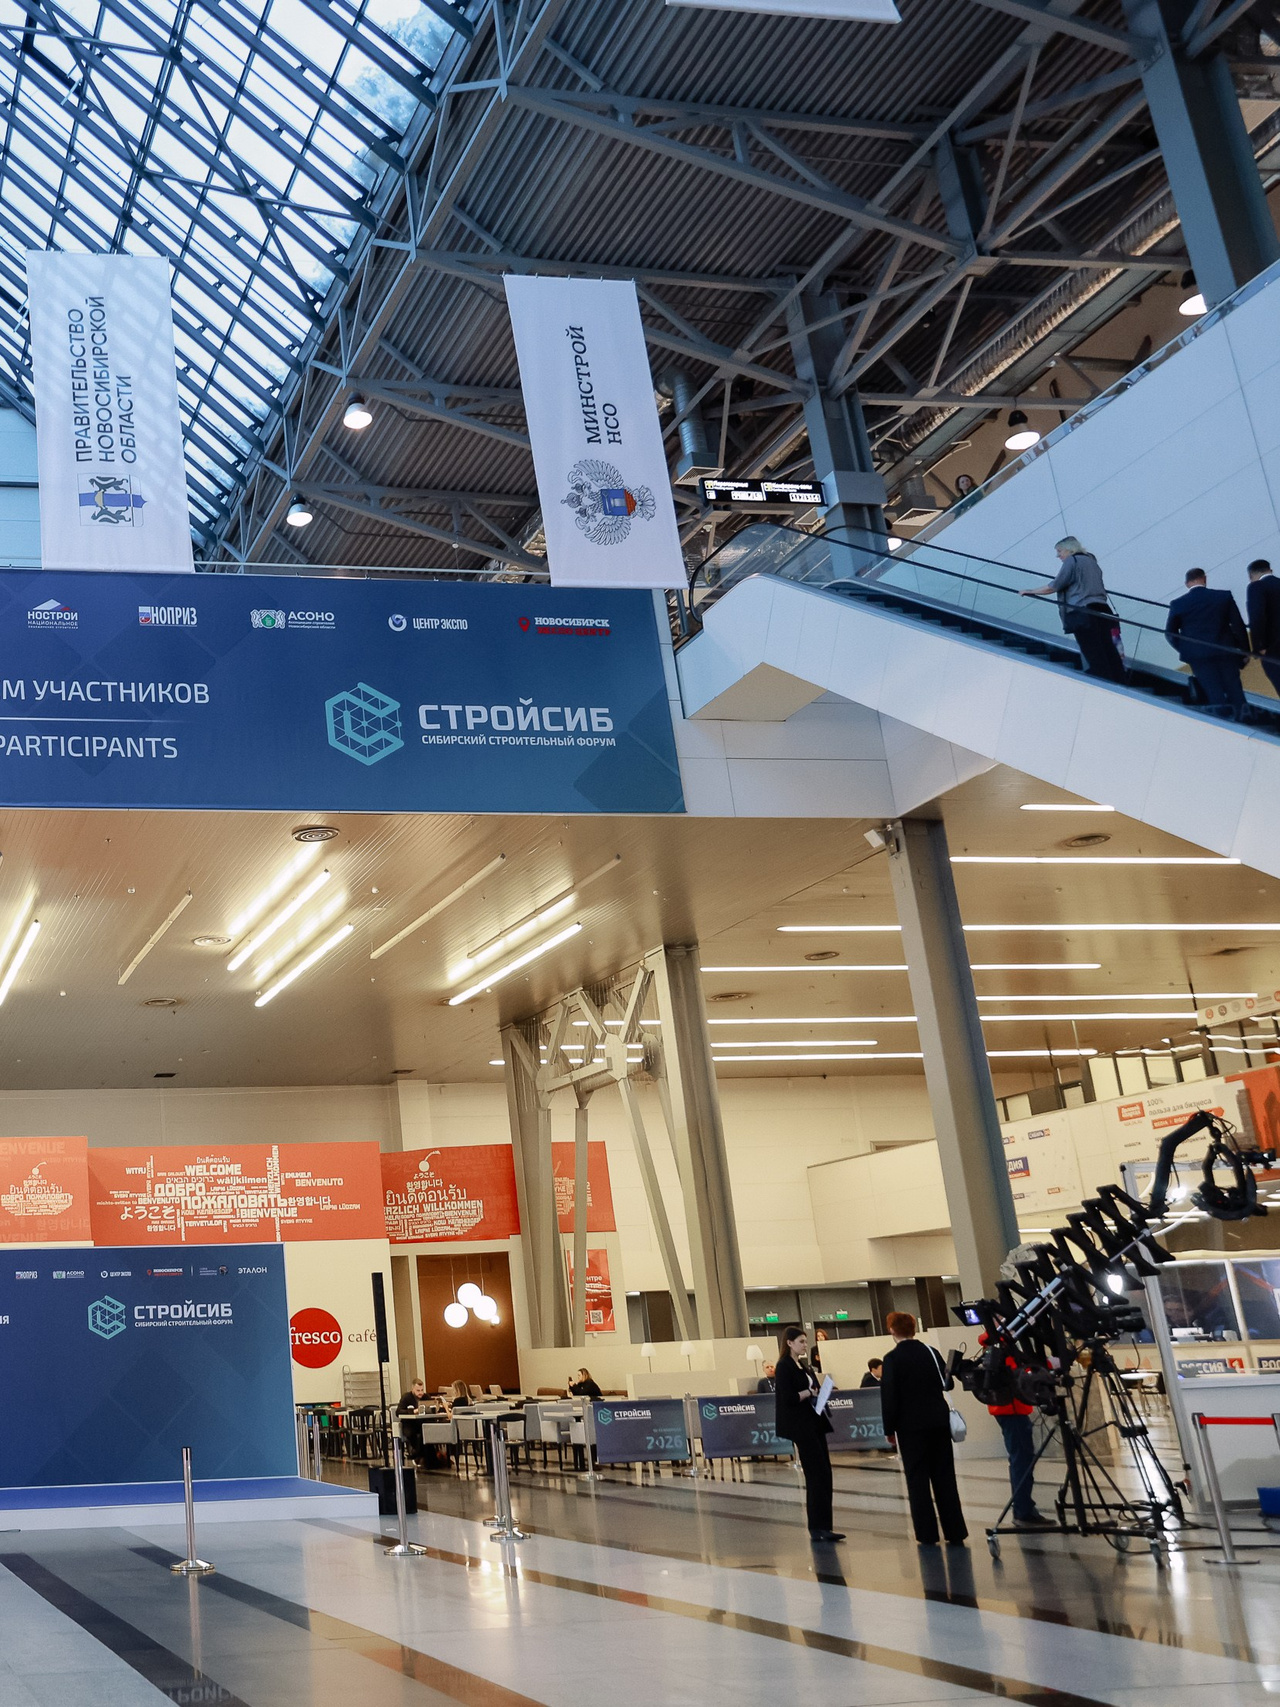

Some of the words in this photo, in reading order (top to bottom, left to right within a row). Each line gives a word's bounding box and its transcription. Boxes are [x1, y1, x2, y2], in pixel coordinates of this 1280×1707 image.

[67, 308, 93, 463] ПРАВИТЕЛЬСТВО
[85, 296, 116, 463] НОВОСИБИРСКОЙ
[565, 325, 601, 444] МИНСТРОЙ
[117, 375, 137, 464] ОБЛАСТИ
[602, 402, 622, 445] НСО
[151, 606, 197, 625] НОПРИЗ
[288, 611, 335, 621] АСОНО
[534, 617, 610, 627] НОВОСИБИРСК
[412, 617, 440, 630] ЦЕНТР
[441, 618, 468, 630] ЭКСПО
[33, 680, 210, 704] УЧАСТНИКОВ
[418, 697, 614, 732] СТРОЙСИБ
[421, 734, 487, 746] СИБИРСКИЙ
[488, 735, 575, 746] СТРОИТЕЛЬНЫЙ
[576, 737, 616, 748] ФОРУМ
[184, 1164, 242, 1176] WELCOME
[154, 1182, 206, 1197] ДОБРО
[295, 1178, 344, 1187] BENVENUTO
[180, 1194, 288, 1210] ПОЖАЛОВАТЬ
[288, 1196, 332, 1206] 환영합니다
[422, 1200, 482, 1212] WILLKOMMEN
[120, 1206, 176, 1220] ようこそ
[240, 1207, 298, 1218] BIENVENUE
[134, 1300, 233, 1320] СТРОЙСИБ
[168, 1319, 212, 1327] СТРОИТЕЛЬНЫЙ
[290, 1326, 341, 1345] fresco
[348, 1328, 377, 1343] café
[614, 1409, 652, 1418] СТРОЙСИБ
[719, 1404, 756, 1412] СТРОЙСИБ
[850, 1424, 884, 1438] 2026
[646, 1436, 683, 1450] 2026
